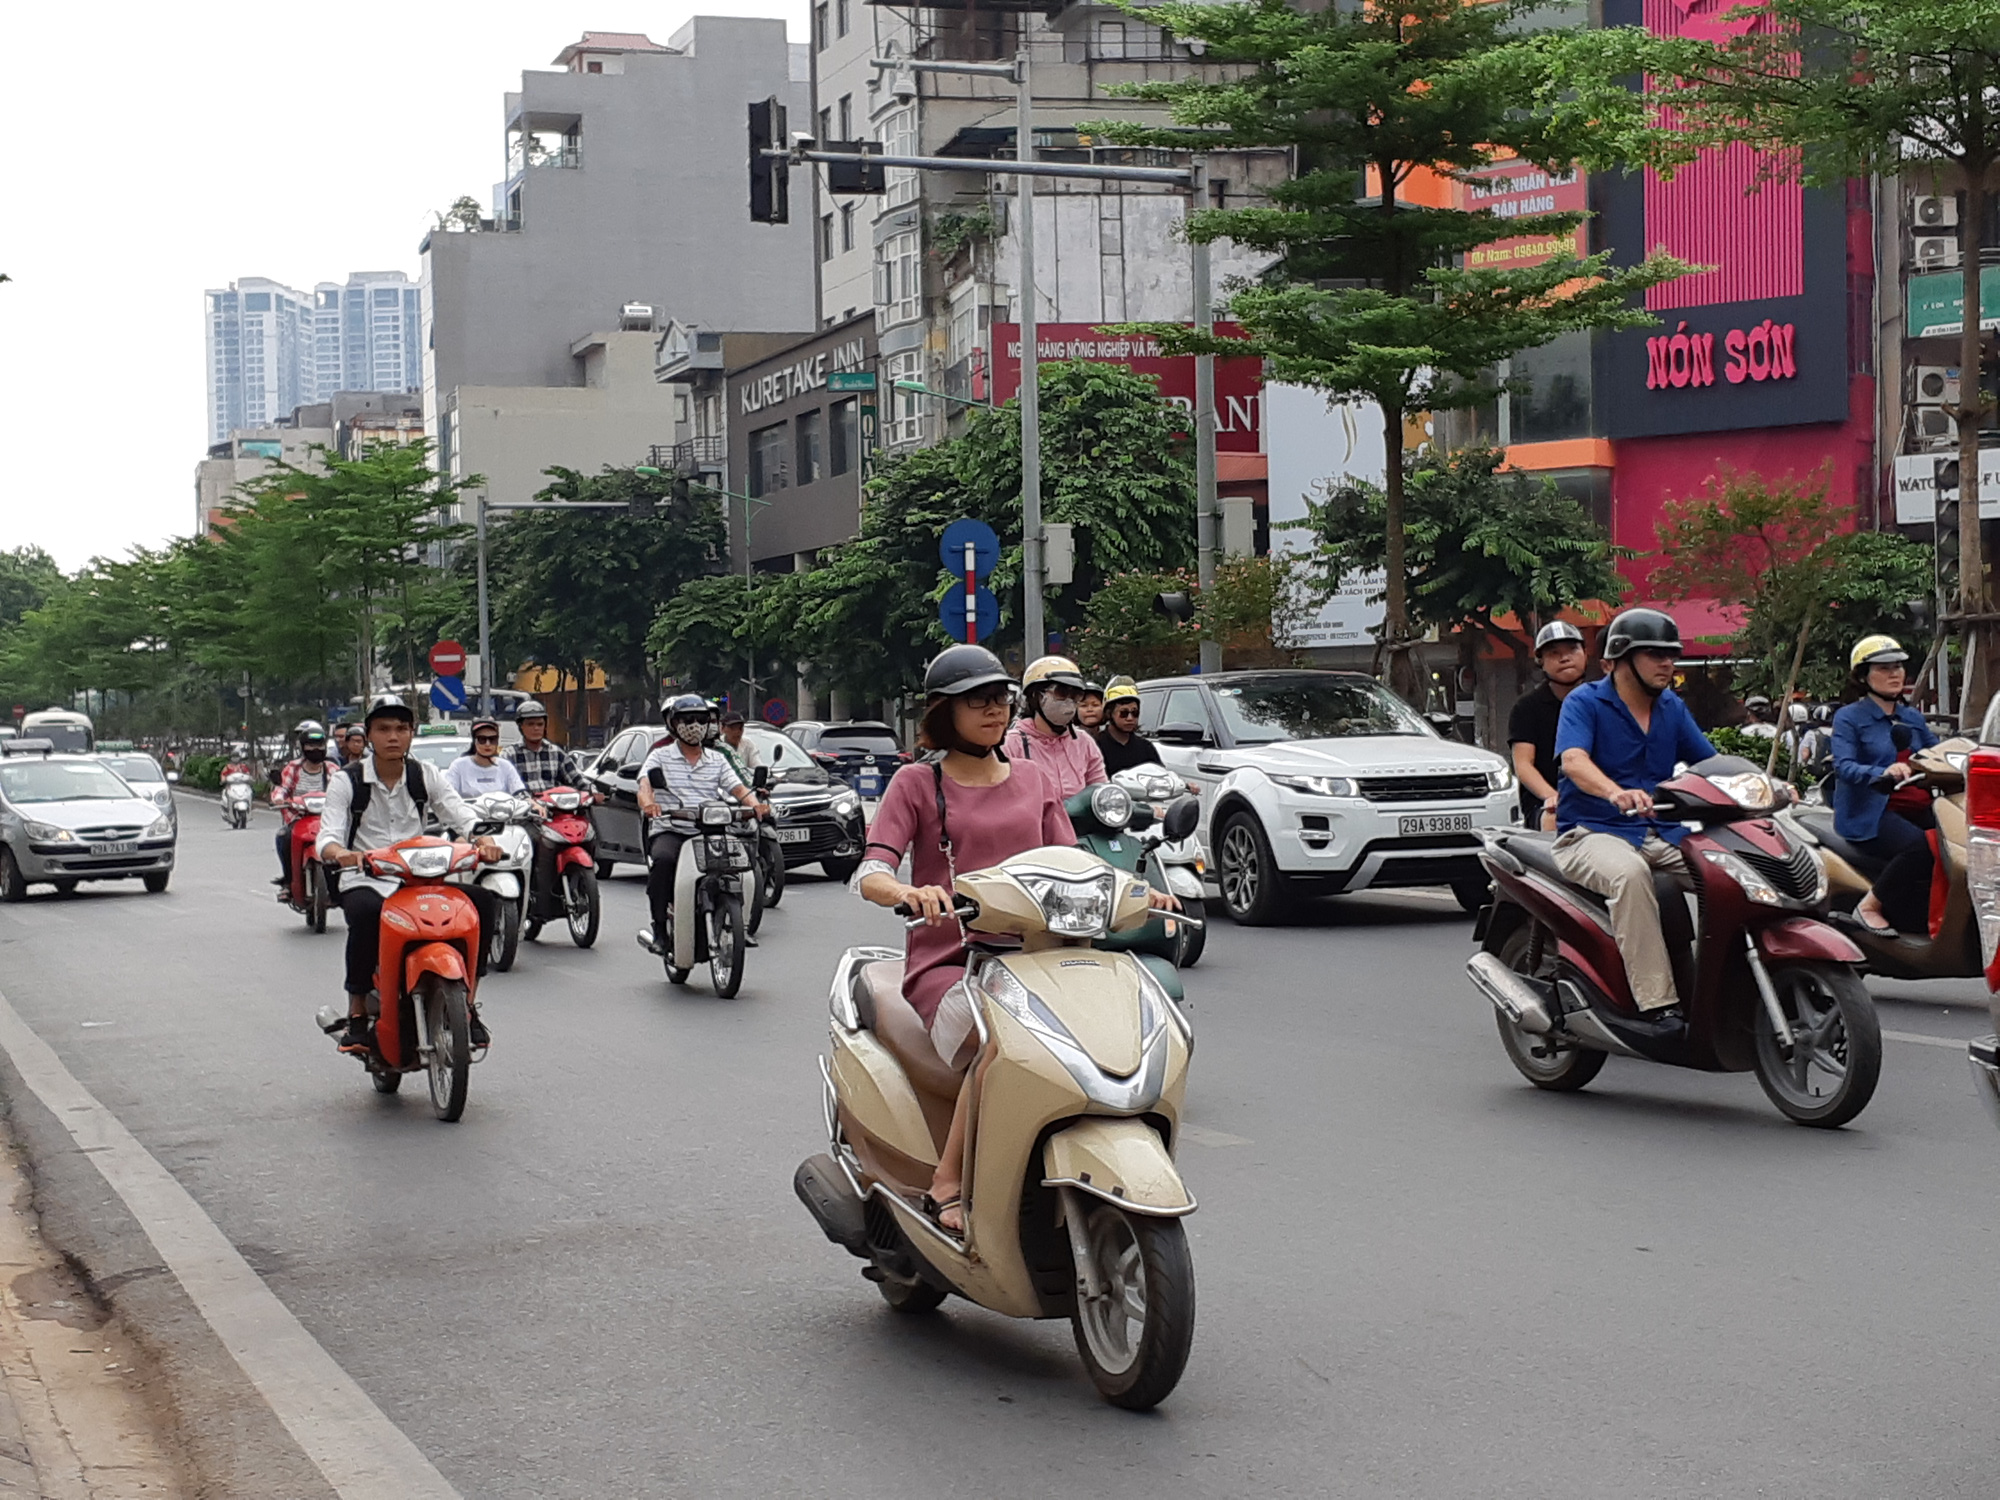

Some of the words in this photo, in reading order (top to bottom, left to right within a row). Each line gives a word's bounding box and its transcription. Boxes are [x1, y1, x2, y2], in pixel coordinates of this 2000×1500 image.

[1520, 195, 1555, 213] HÀNG
[1037, 337, 1065, 358] HÀNG
[1067, 338, 1095, 358] NÔNG
[1097, 338, 1130, 361] NGHIỆP
[1132, 337, 1145, 357] VÀ
[1646, 320, 1715, 390] NÓN
[1724, 318, 1796, 384] SƠN
[741, 353, 827, 416] KURETAKE
[833, 337, 864, 374] INN
